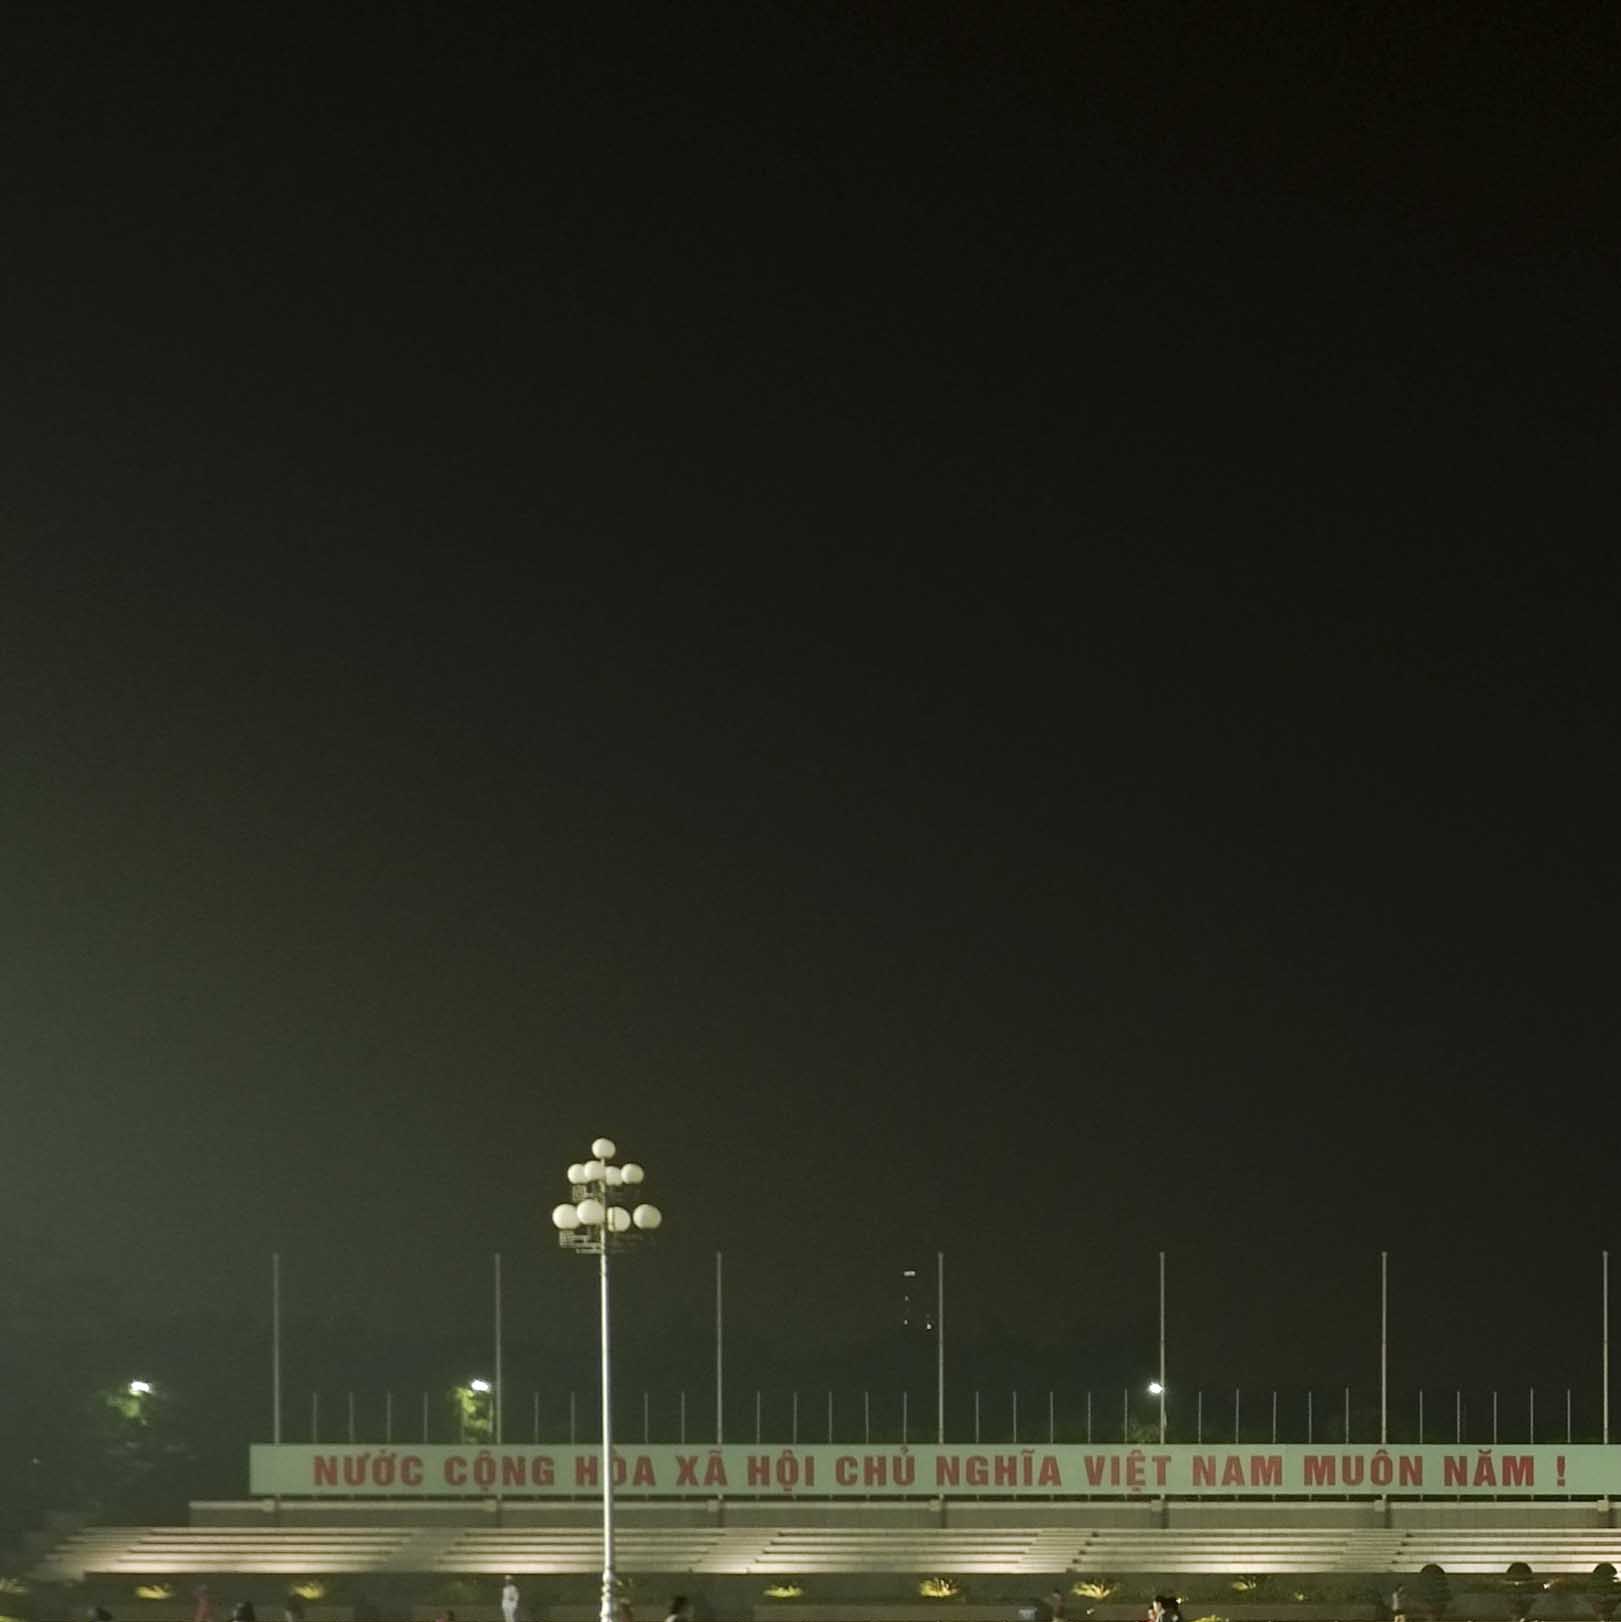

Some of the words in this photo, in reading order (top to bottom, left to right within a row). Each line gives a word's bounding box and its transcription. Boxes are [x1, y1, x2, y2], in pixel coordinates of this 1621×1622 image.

[313, 1449, 424, 1487] NƯỚC
[444, 1449, 555, 1491] CỘNG
[675, 1450, 727, 1487] XÃ
[747, 1449, 815, 1491] HỘI
[835, 1446, 915, 1487] CHỦ
[935, 1449, 1061, 1487] NGHĨA
[1084, 1449, 1171, 1492] VIỆT
[1192, 1455, 1282, 1487] NAM
[1303, 1449, 1423, 1487] MUÔN
[1443, 1449, 1536, 1487] NĂM
